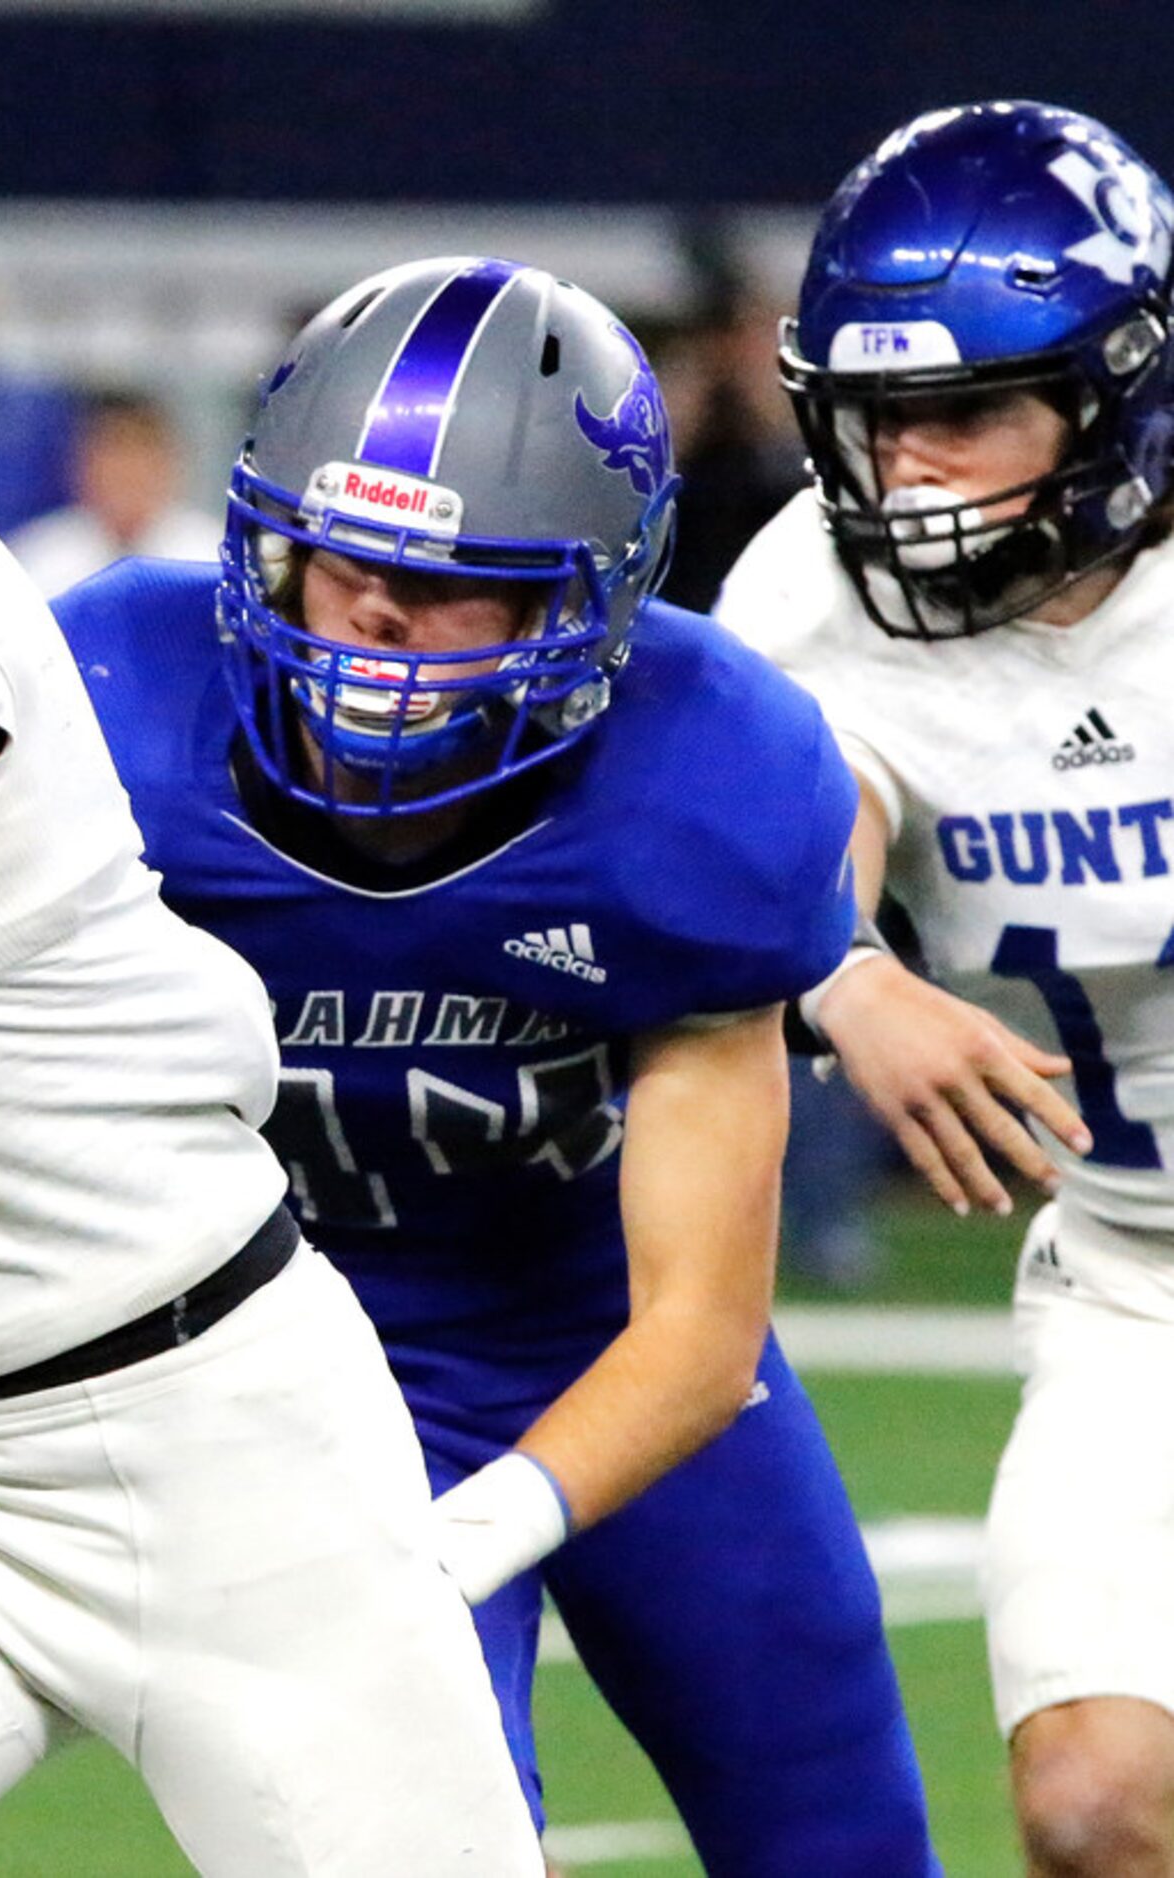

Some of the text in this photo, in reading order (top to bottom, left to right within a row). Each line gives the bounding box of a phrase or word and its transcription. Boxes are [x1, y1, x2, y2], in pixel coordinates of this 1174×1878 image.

[344, 472, 428, 512] Riddell
[1051, 745, 1135, 771] adidas
[936, 799, 1173, 885] GUNT
[503, 939, 606, 983] adidas
